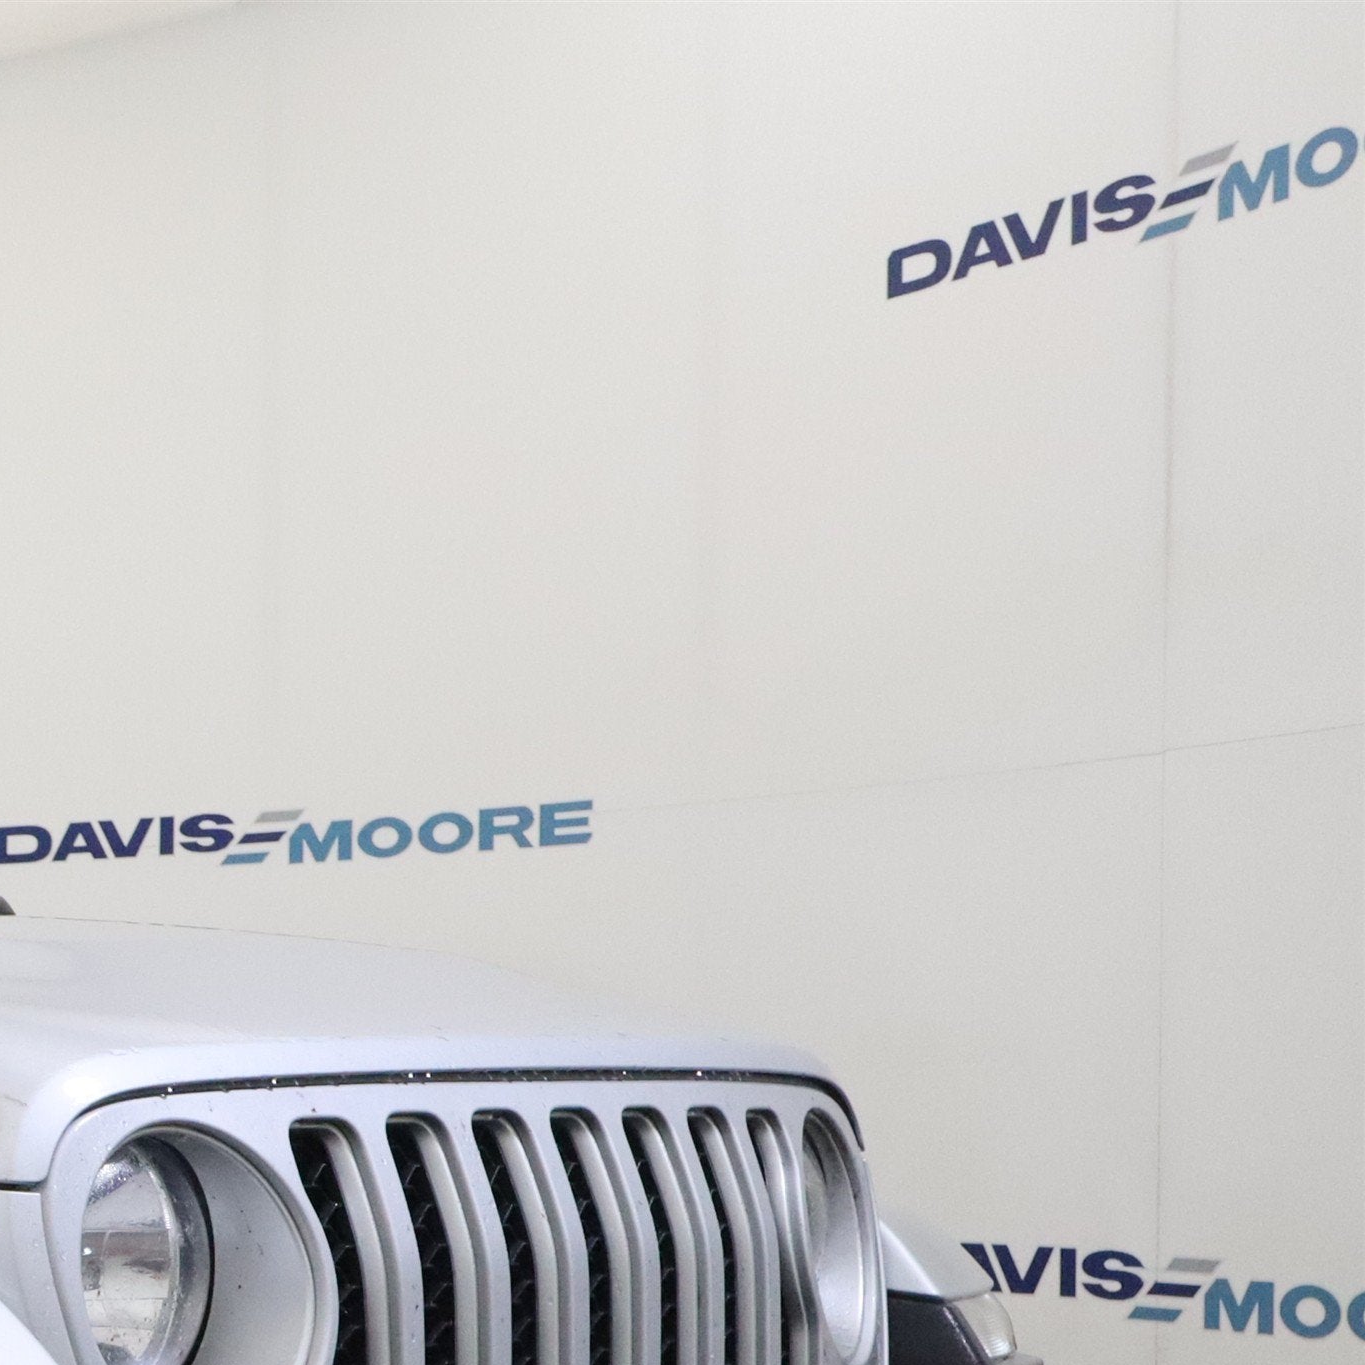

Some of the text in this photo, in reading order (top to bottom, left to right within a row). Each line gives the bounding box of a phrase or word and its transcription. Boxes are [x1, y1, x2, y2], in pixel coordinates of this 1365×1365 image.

[886, 126, 1365, 300] DAVIS MO
[287, 799, 593, 865] MOORE
[961, 1243, 1365, 1340] VIS MO
